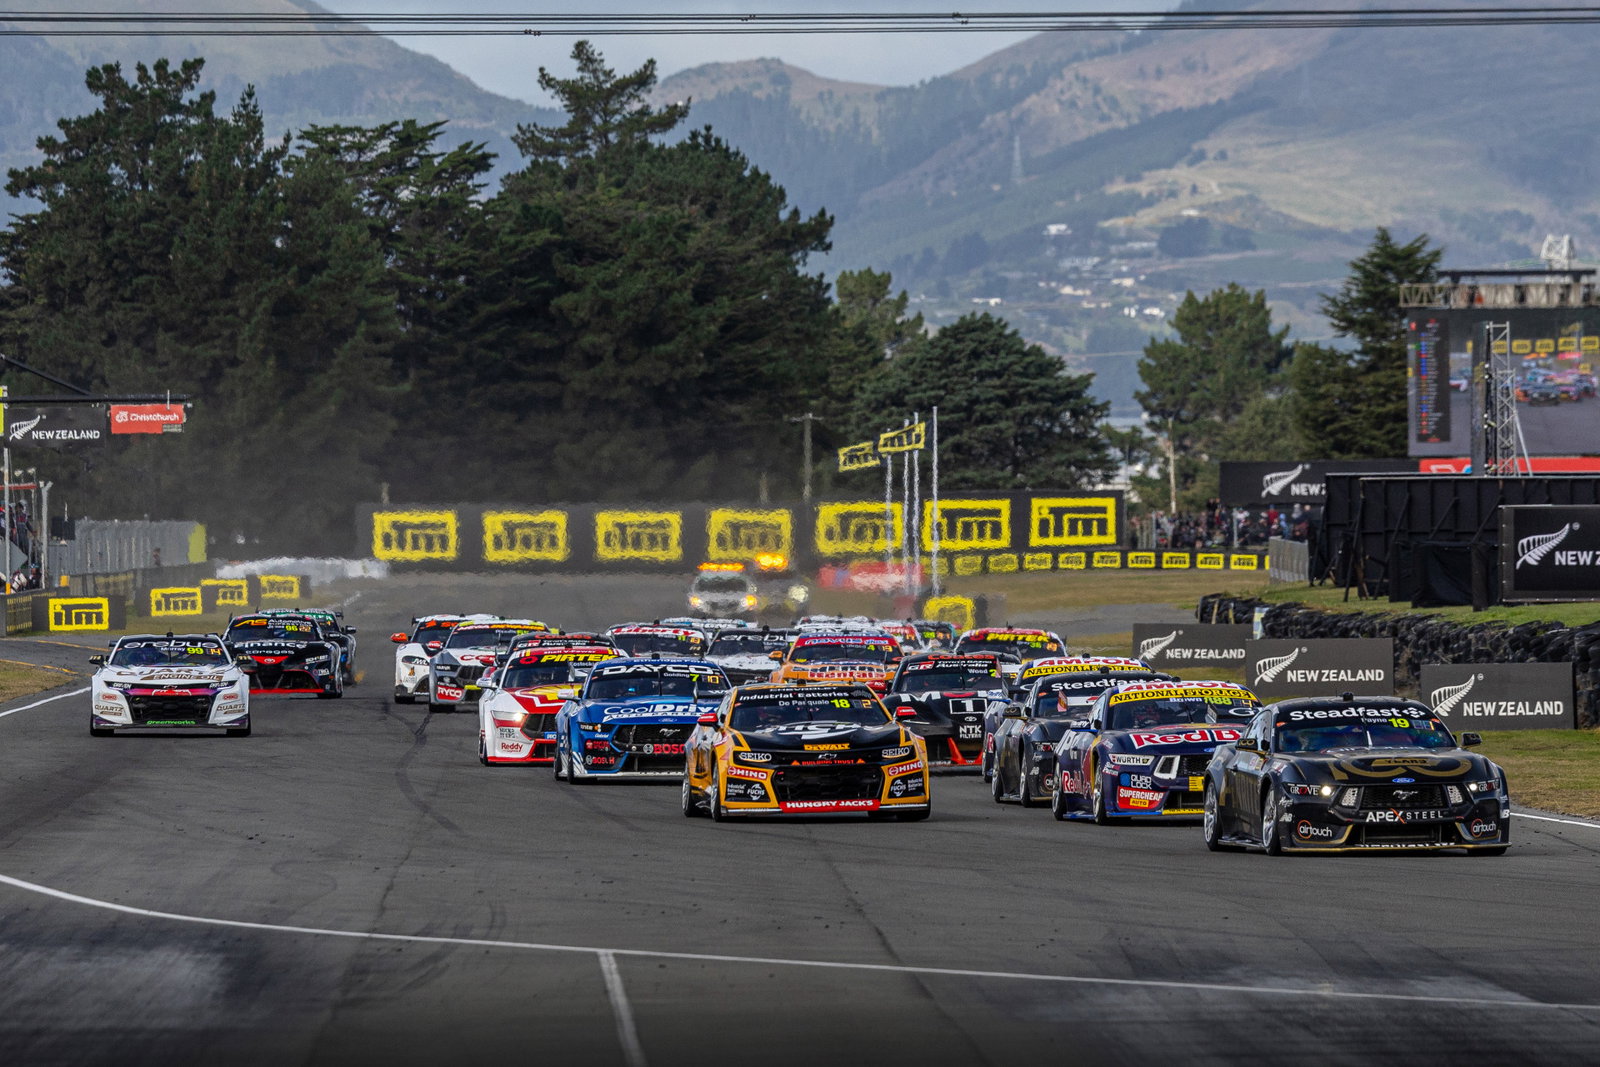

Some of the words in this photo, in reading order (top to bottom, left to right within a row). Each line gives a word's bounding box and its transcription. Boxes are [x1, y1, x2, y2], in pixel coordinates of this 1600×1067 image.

[129, 412, 180, 422] Christchurch
[31, 430, 52, 440] NEW
[55, 429, 101, 440] ZEALAND
[1290, 482, 1320, 497] NEW
[1555, 550, 1591, 566] NEW
[721, 632, 786, 641] erebu
[186, 647, 204, 655] 99
[1166, 648, 1192, 659] NEW
[1193, 648, 1246, 659] ZEALAND
[540, 652, 617, 663] PIRTEK
[602, 664, 714, 675] DAYCO
[1026, 664, 1089, 676] NATIONAL
[1287, 670, 1316, 682] NEW
[1318, 668, 1385, 682] ZEALAND
[689, 673, 699, 682] 7
[1122, 681, 1238, 691] AMPOL
[437, 686, 462, 698] RYCO
[739, 693, 794, 701] Industrial
[1113, 689, 1184, 703] NATIONAL
[1184, 688, 1252, 698] STORAGE
[94, 704, 124, 712] QUARTZ
[830, 698, 851, 709] 18
[961, 699, 974, 712] 1
[1463, 702, 1496, 716] NEW
[1497, 700, 1564, 716] ZEALAND
[1290, 707, 1402, 721] Steadfast
[1387, 717, 1410, 728] 19
[959, 725, 982, 733] NTK
[1130, 730, 1211, 749] Red
[501, 742, 523, 752] Reddy
[653, 743, 685, 754] BOSC
[803, 743, 851, 751] DEWALT
[881, 747, 910, 757] SEIKO
[739, 752, 772, 761] SEIKO
[898, 760, 923, 773] HINO
[736, 768, 767, 780] HINO
[1130, 774, 1152, 783] QUAD
[1130, 781, 1152, 789] LOCK
[746, 788, 766, 796] FUCHS
[1119, 788, 1164, 801] SUPERCHEAP
[1289, 786, 1320, 796] GROVE
[1365, 808, 1406, 824] APEX
[1406, 810, 1443, 820] STEEL
[1299, 824, 1333, 837] airtouch
[1472, 820, 1497, 833] airtouch
